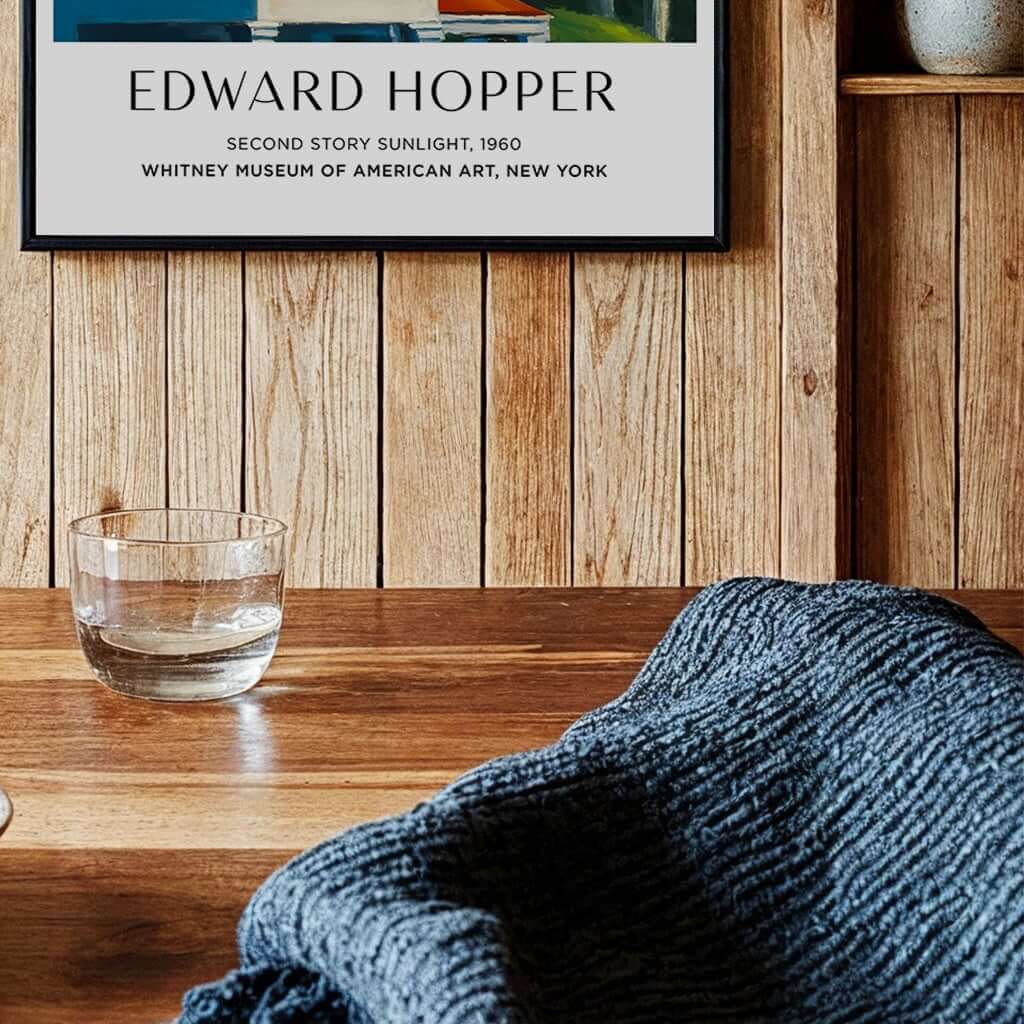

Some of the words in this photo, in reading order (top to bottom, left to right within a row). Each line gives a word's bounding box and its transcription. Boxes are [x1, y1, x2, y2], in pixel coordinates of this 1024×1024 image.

[130, 69, 364, 112] EDWARD
[389, 69, 616, 113] HOPPER
[226, 136, 304, 151] SECOND
[310, 136, 371, 151] STORY
[377, 136, 474, 153] SUNLIGHT,
[479, 137, 522, 151] 1960
[141, 163, 229, 178] WHITNEY
[235, 163, 314, 178] MUSEUM
[320, 163, 347, 178] OF
[352, 163, 452, 178] AMERICAN
[458, 163, 500, 180] ART,
[506, 163, 550, 178] NEW
[556, 163, 608, 178] YORK
